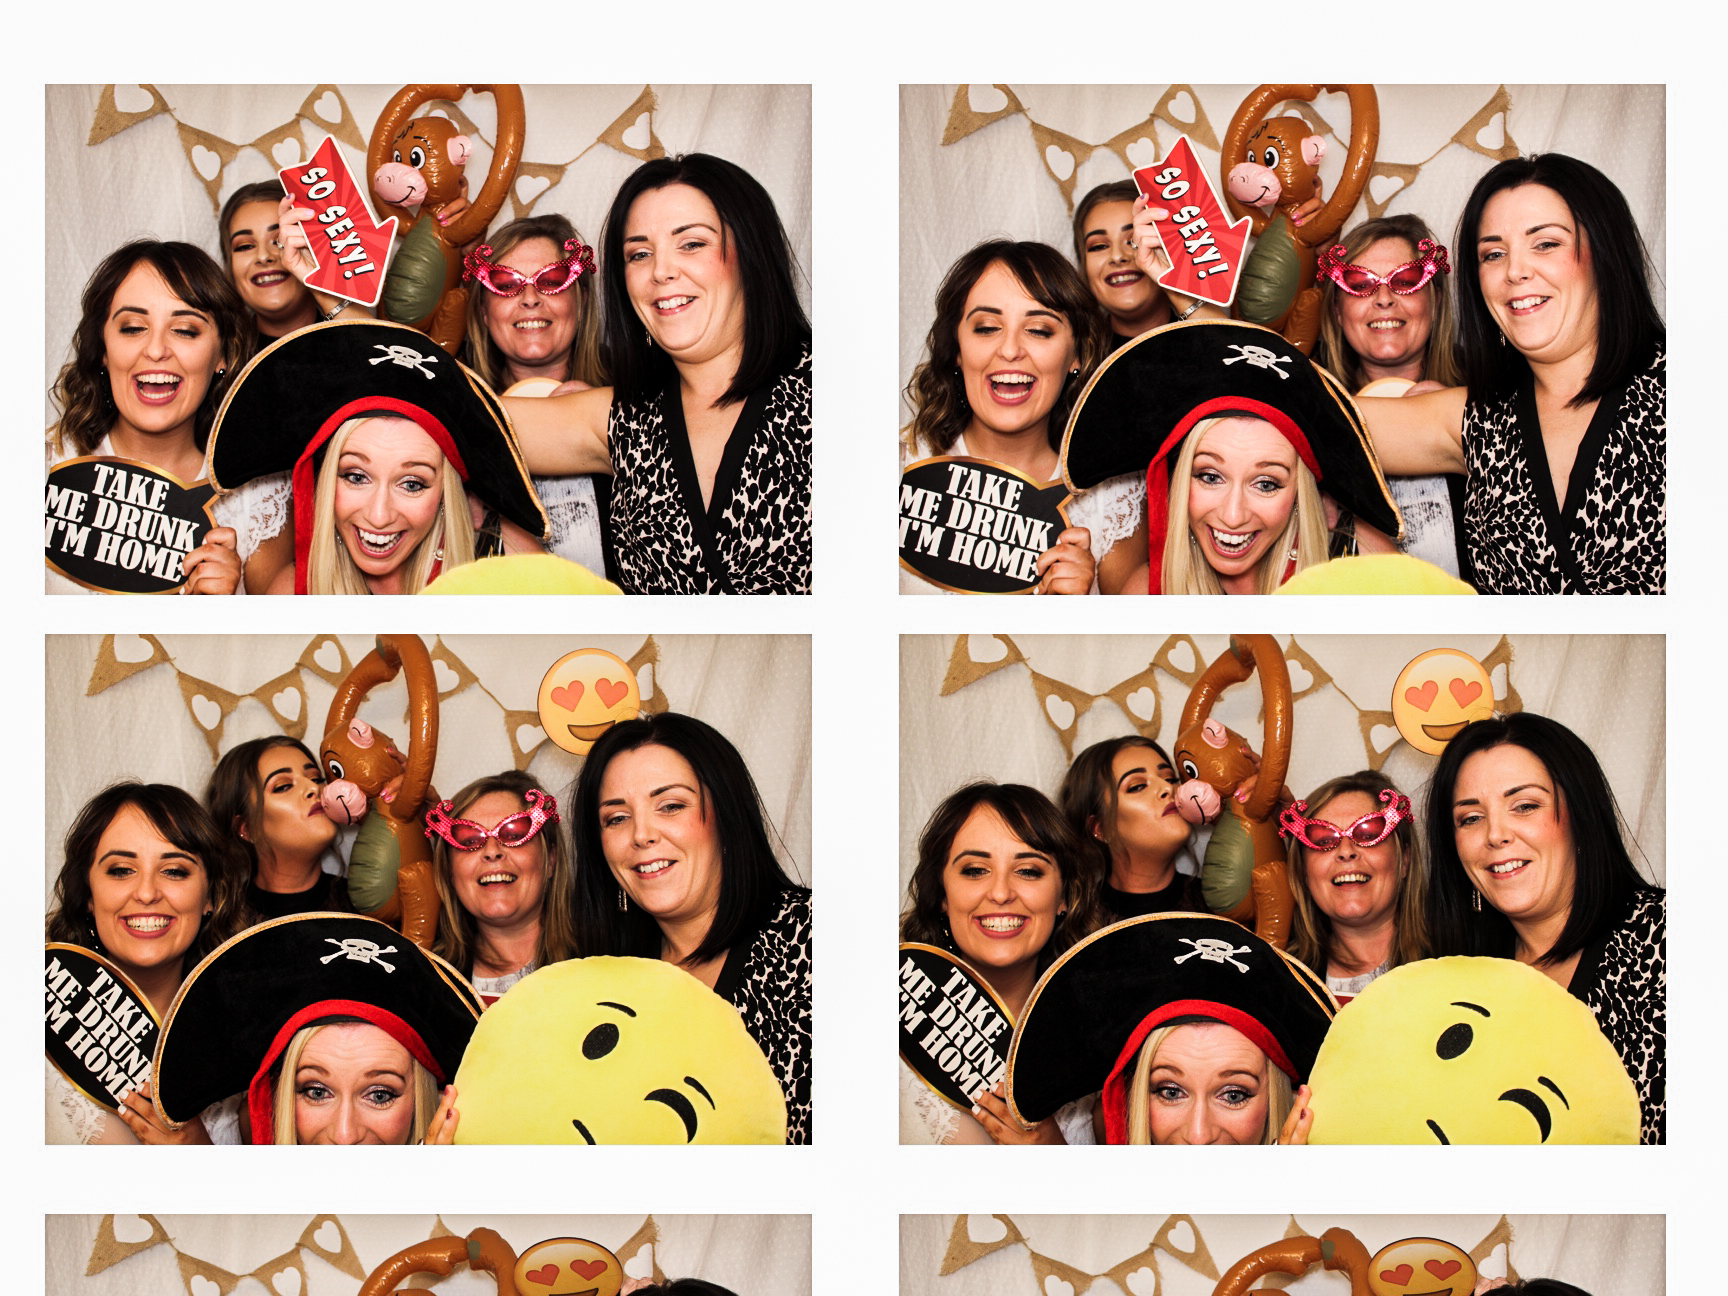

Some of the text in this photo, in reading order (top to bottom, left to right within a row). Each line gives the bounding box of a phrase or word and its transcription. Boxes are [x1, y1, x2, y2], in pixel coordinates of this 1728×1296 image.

[300, 167, 376, 280] SO SEXY!
[1154, 167, 1230, 280] SO SEXY!
[45, 484, 200, 553] ME DRUNK
[91, 463, 170, 512] TAKE
[899, 484, 1054, 553] ME DRUNK
[945, 463, 1024, 512] TAKE
[45, 516, 187, 583] I'M HOME
[899, 516, 1041, 583] I'M HOME
[45, 957, 83, 1006] ME
[87, 966, 154, 1044] TAKE
[899, 957, 937, 1006] ME
[941, 966, 1008, 1044] TAKE
